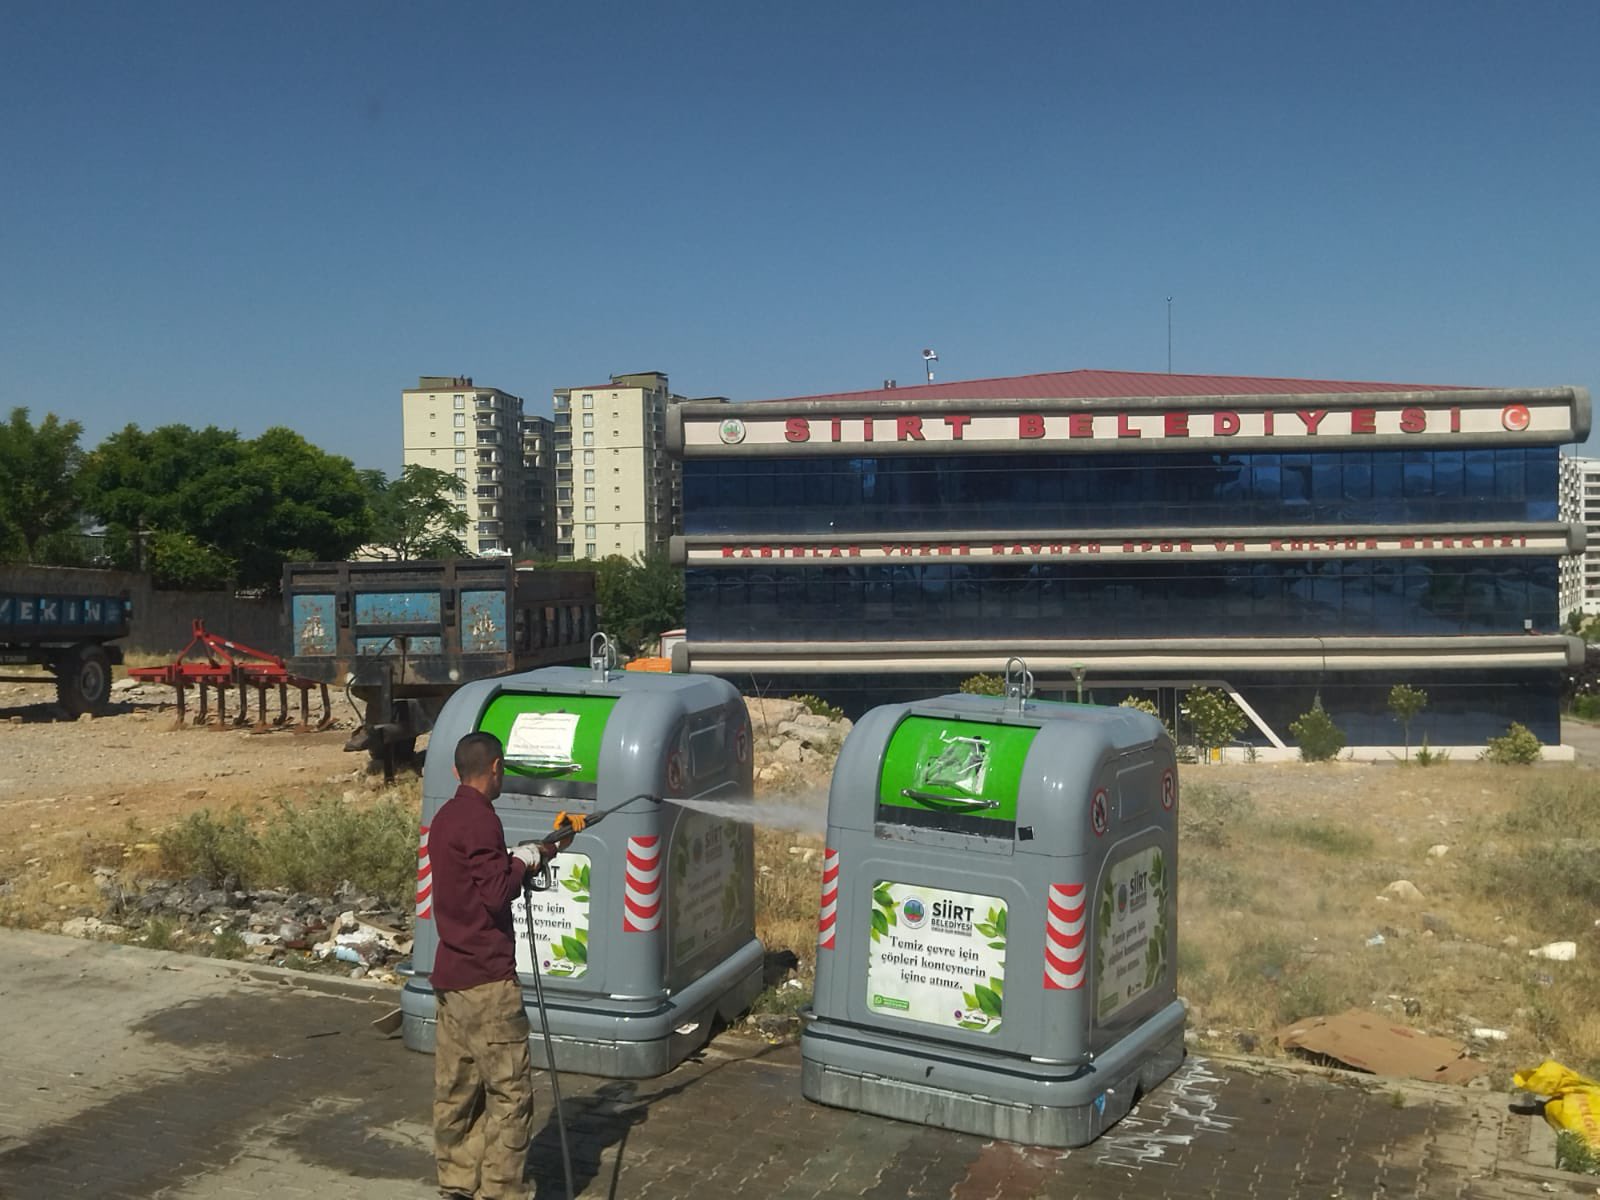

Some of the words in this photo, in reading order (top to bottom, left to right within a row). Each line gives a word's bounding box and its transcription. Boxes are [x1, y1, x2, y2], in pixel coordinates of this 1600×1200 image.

[932, 899, 974, 921] SİİRT
[931, 918, 972, 931] BELEDİYESİ
[890, 935, 923, 952] Temiz
[927, 945, 956, 957] çevre
[959, 947, 979, 961] için
[881, 952, 918, 967] çöpleri
[921, 957, 986, 977] konteynerin
[900, 969, 926, 983] içine
